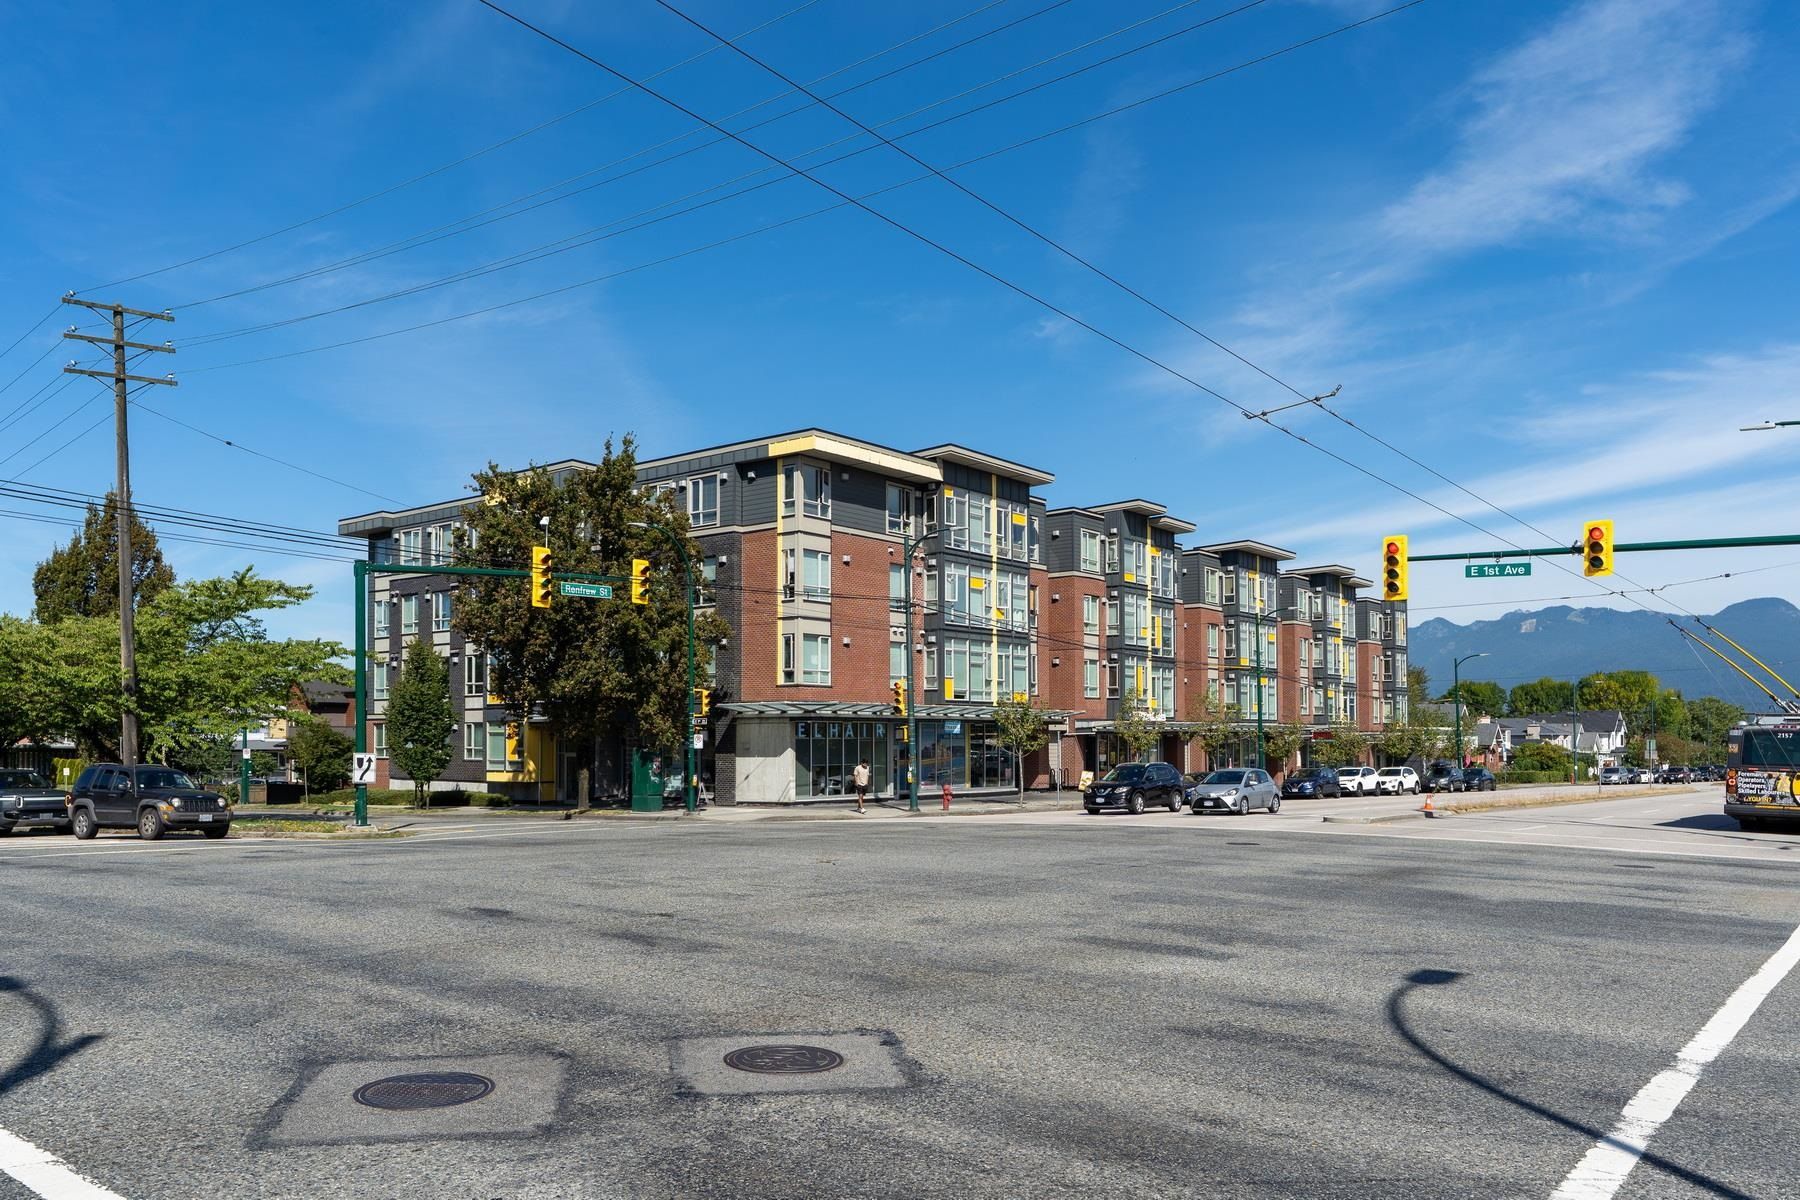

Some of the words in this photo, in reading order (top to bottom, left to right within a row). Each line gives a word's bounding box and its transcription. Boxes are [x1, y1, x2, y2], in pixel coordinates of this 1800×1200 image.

[1471, 566, 1479, 576] E
[1483, 566, 1499, 576] 1st
[1504, 565, 1525, 575] Ave
[565, 585, 596, 595] Renfrew
[600, 587, 608, 596] St
